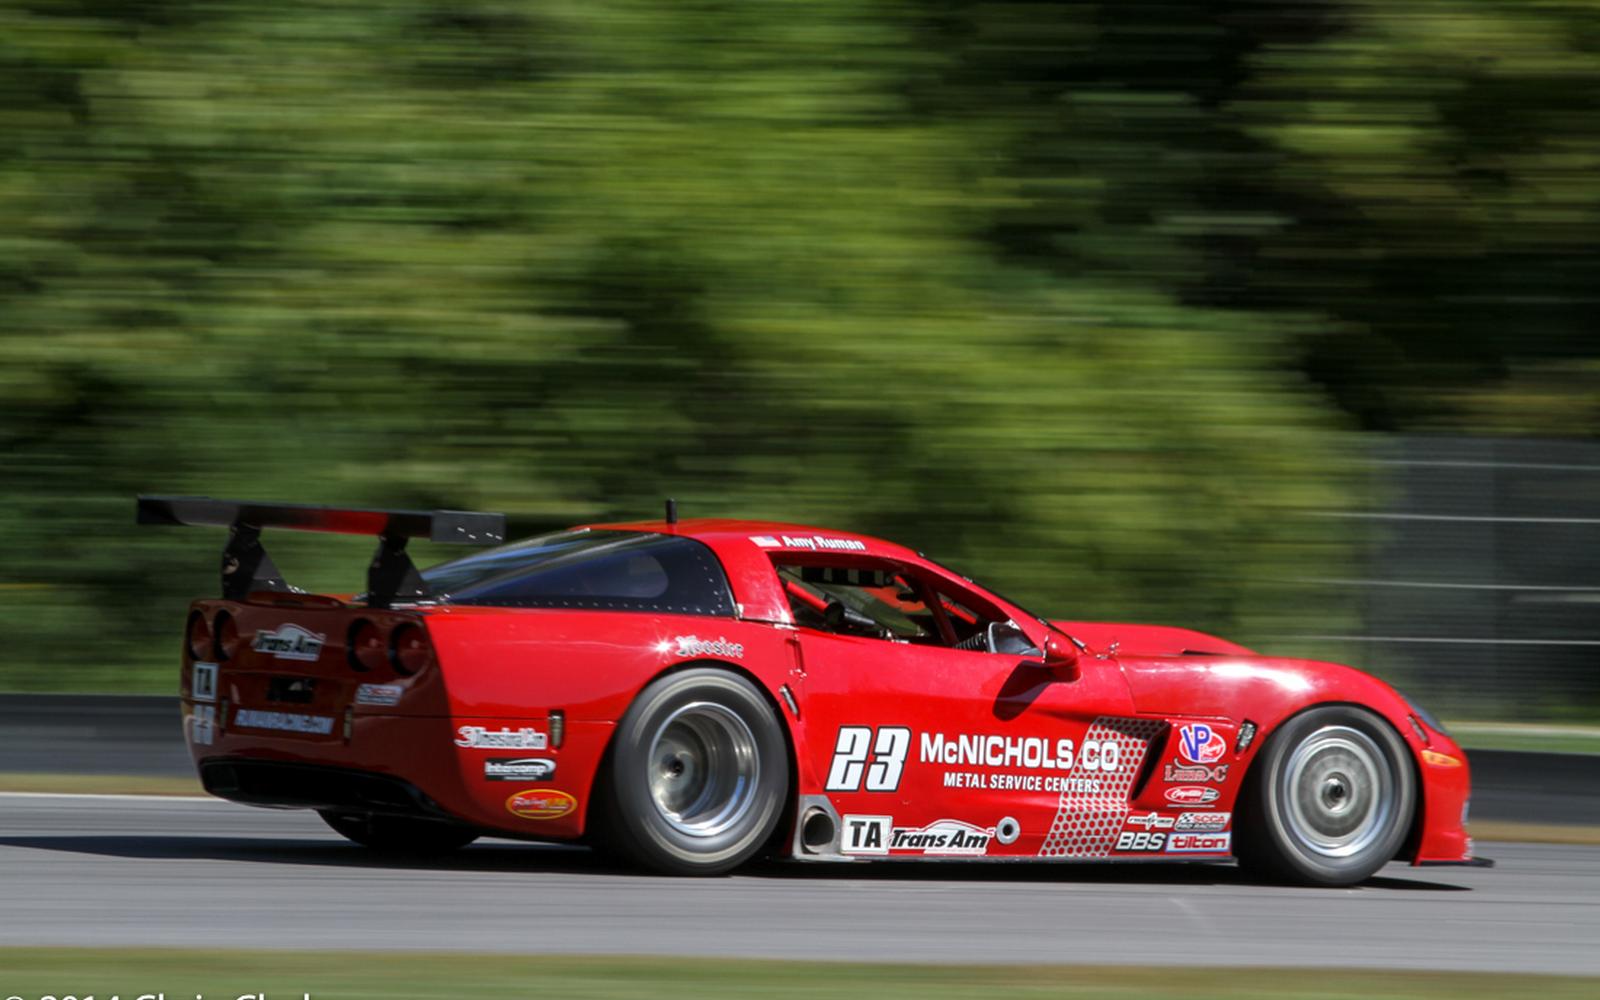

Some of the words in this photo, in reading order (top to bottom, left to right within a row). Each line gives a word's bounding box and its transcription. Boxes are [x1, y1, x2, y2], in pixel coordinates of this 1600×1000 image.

[781, 536, 816, 551] Amy
[814, 536, 866, 551] Ruman
[920, 733, 1073, 770] McNICHOLS
[1081, 740, 1124, 772] CO.
[1181, 725, 1210, 761] VP
[824, 726, 911, 792] 23
[944, 772, 987, 789] METAL
[989, 774, 1043, 791] SERVICE
[1044, 777, 1100, 794] CENTERS
[1193, 815, 1225, 824] SCCA
[849, 821, 882, 848] TA
[891, 829, 947, 848] Trans
[948, 829, 989, 849] Am
[1115, 832, 1166, 851] BBS
[1171, 836, 1226, 849] tilton
